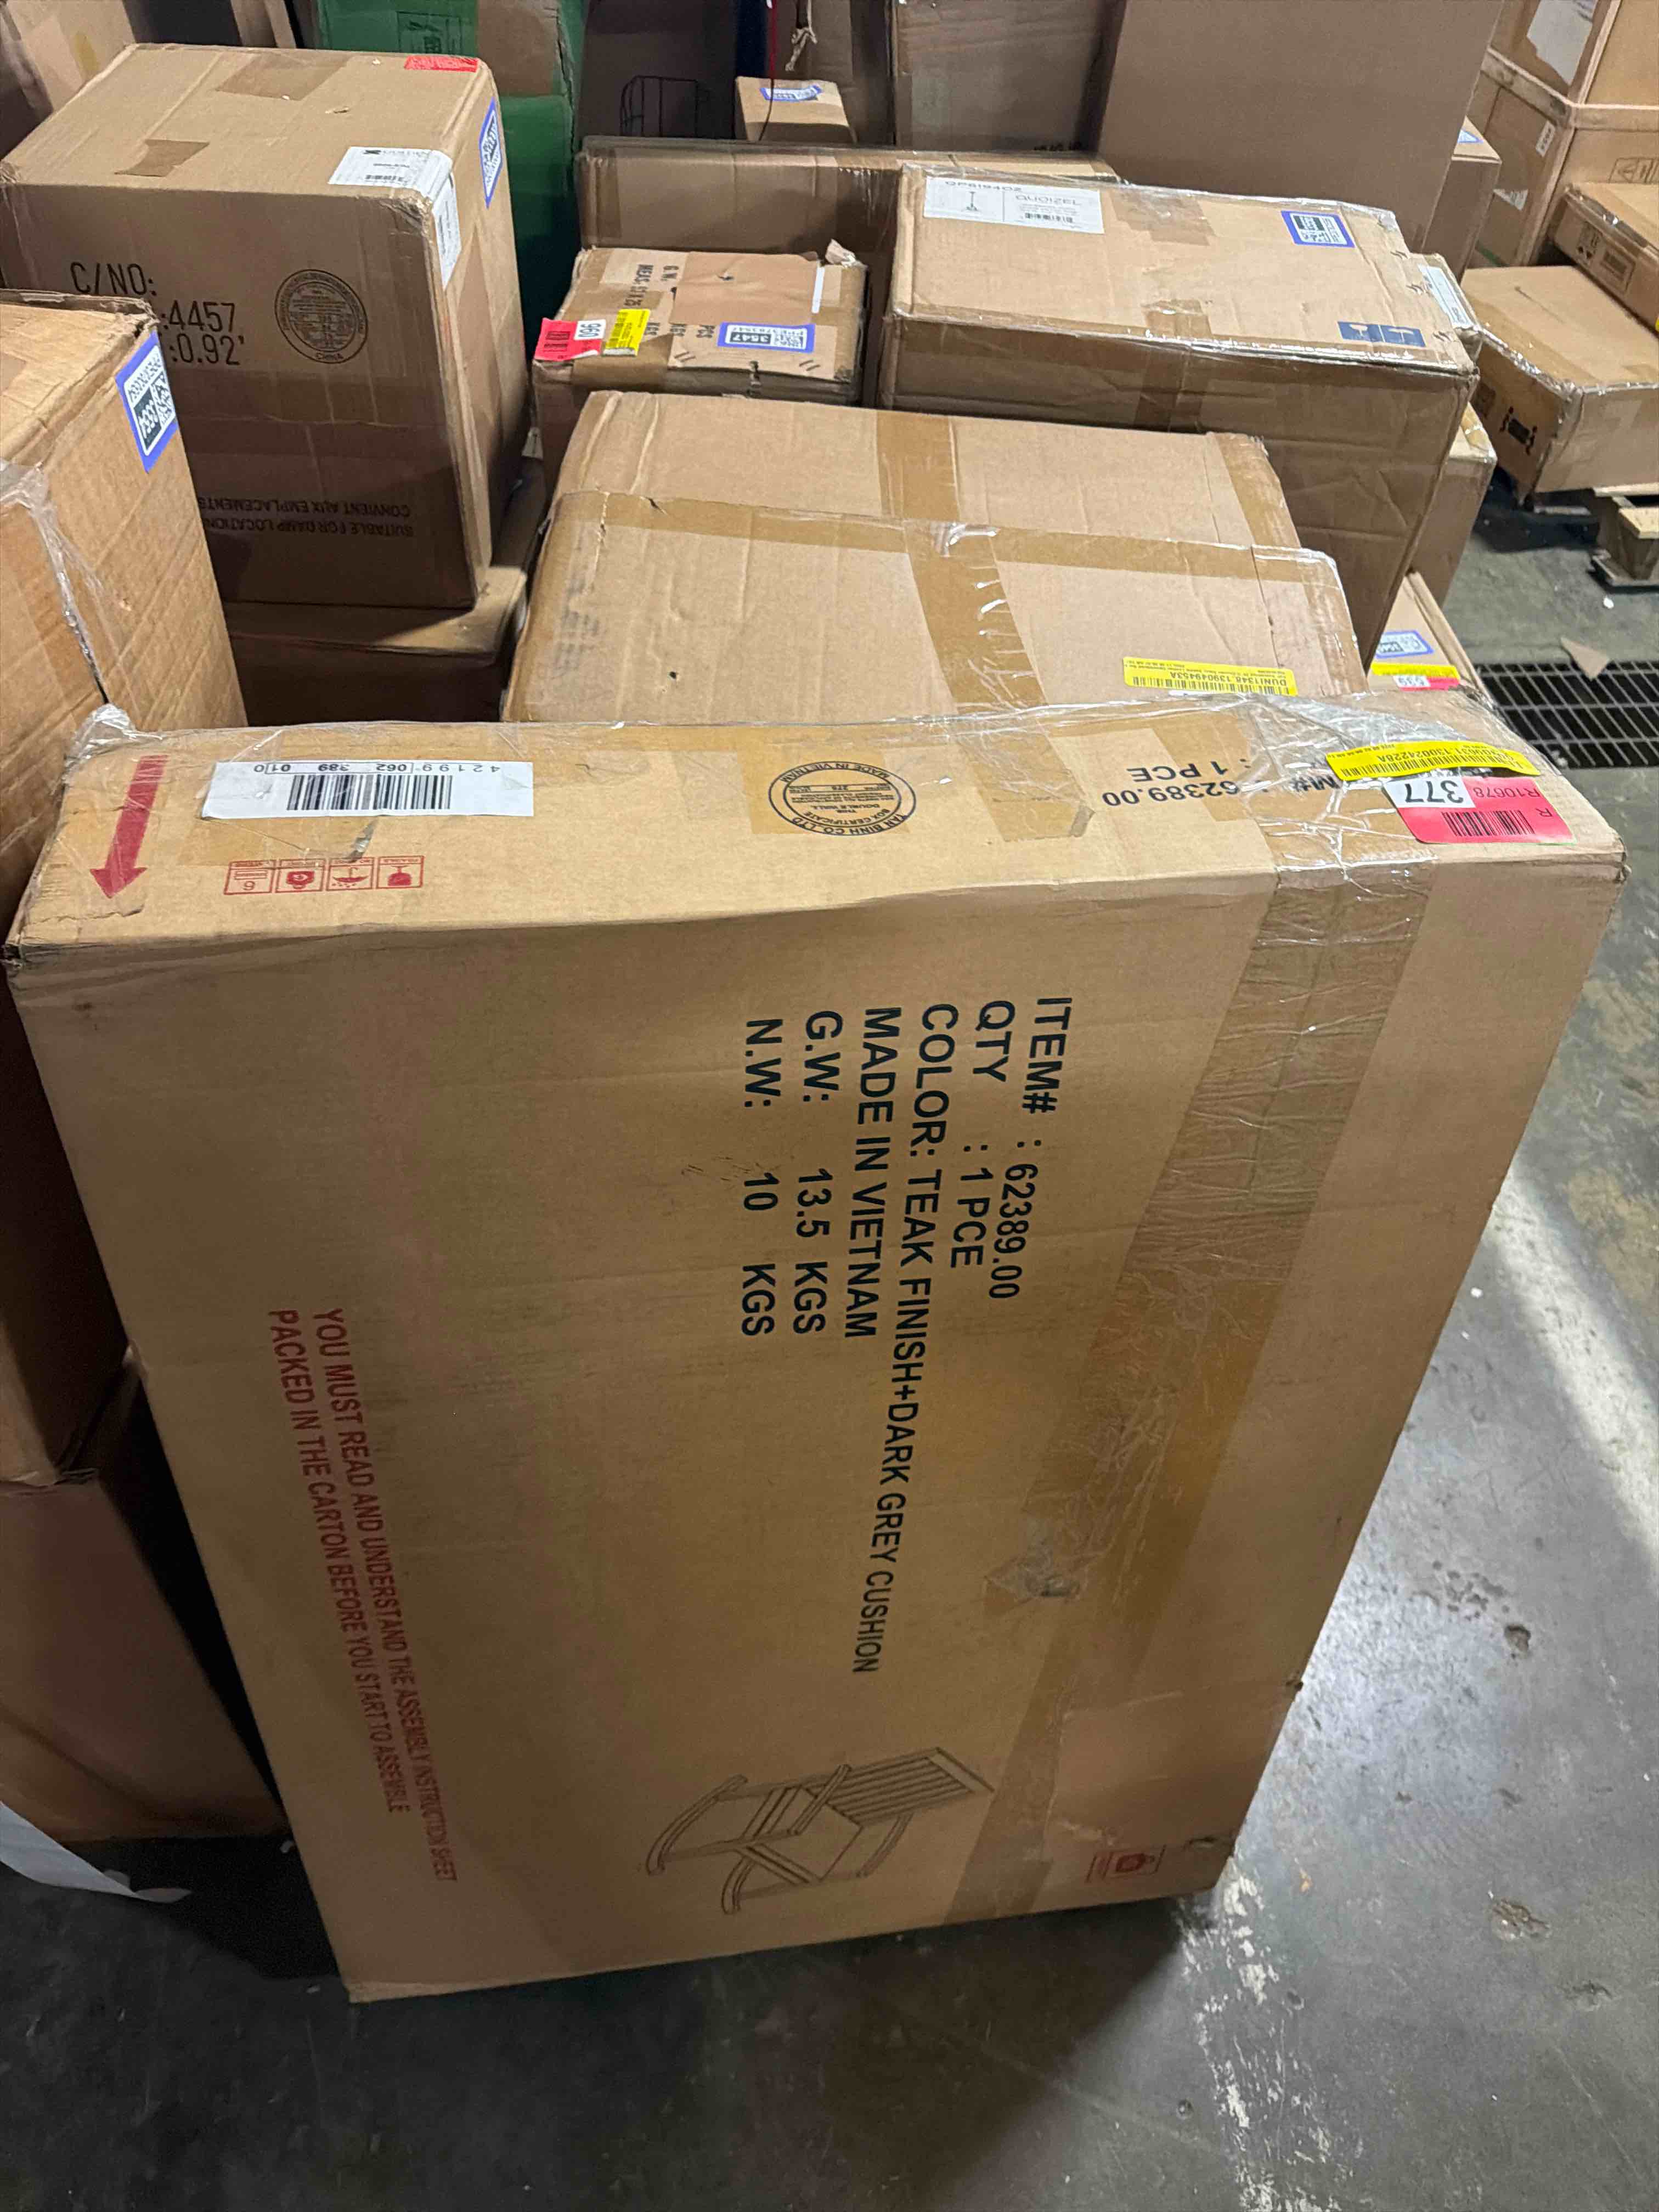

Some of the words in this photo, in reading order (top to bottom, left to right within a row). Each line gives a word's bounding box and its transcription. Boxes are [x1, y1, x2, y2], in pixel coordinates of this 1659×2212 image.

[1015, 194, 1081, 206] QUOIZEL
[70, 262, 157, 296] C/NO:
[578, 322, 601, 338] 960
[732, 334, 769, 342] 3547
[319, 522, 346, 535] FOR
[351, 521, 413, 537] SUITABLE
[318, 763, 349, 771] 389
[376, 763, 407, 772] 062
[780, 763, 829, 782] VIETNAM
[855, 763, 890, 778] MADE
[1126, 763, 1201, 782] PCE
[1210, 760, 1228, 776] 1
[1103, 781, 1239, 806] 62389.00
[1405, 780, 1463, 804] 377
[1472, 786, 1541, 798] R10678
[804, 811, 870, 826] CERTIFICATE
[873, 809, 890, 820] BOX
[1536, 807, 1553, 817] R
[242, 881, 255, 891] 6
[803, 1011, 843, 1102] G.W:
[973, 1000, 1015, 1082] QTY
[1022, 997, 1073, 1114] ITEM#
[857, 1007, 901, 1125] MADE
[910, 1004, 959, 1157] COLOR:
[854, 1137, 891, 1171] IN
[743, 1172, 780, 1211] 10
[960, 1167, 994, 1181] 1
[796, 1168, 833, 1238] 13.5
[900, 1169, 943, 1267] TEAK
[950, 1197, 991, 1268] PCE
[989, 1164, 1039, 1299] 62389.00
[844, 1182, 887, 1338] VIETNAM
[741, 1263, 776, 1336] KGS
[793, 1261, 828, 1334] KGS
[313, 1308, 350, 1356] YOU
[268, 1309, 315, 1403] PACKED
[323, 1364, 363, 1424] MUST
[290, 1410, 321, 1431] IN
[297, 1436, 331, 1476] THE
[338, 1430, 375, 1487] READ
[308, 1482, 350, 1560] CARTON
[351, 1493, 383, 1532] AND
[870, 1493, 906, 1563] GREY
[328, 1565, 368, 1633] BEFORE
[359, 1537, 408, 1652] UNDERSTAND
[853, 1571, 894, 1673] CUSHION
[345, 1635, 379, 1668] YOU
[388, 1656, 415, 1685] THE
[356, 1673, 388, 1719] START
[369, 1722, 393, 1742] TO
[394, 1690, 432, 1760] ASSEMBLY
[373, 1746, 410, 1813] ASSEMBLE
[414, 1766, 449, 1846] INSTRUCTION
[430, 1847, 458, 1882] SHEET
